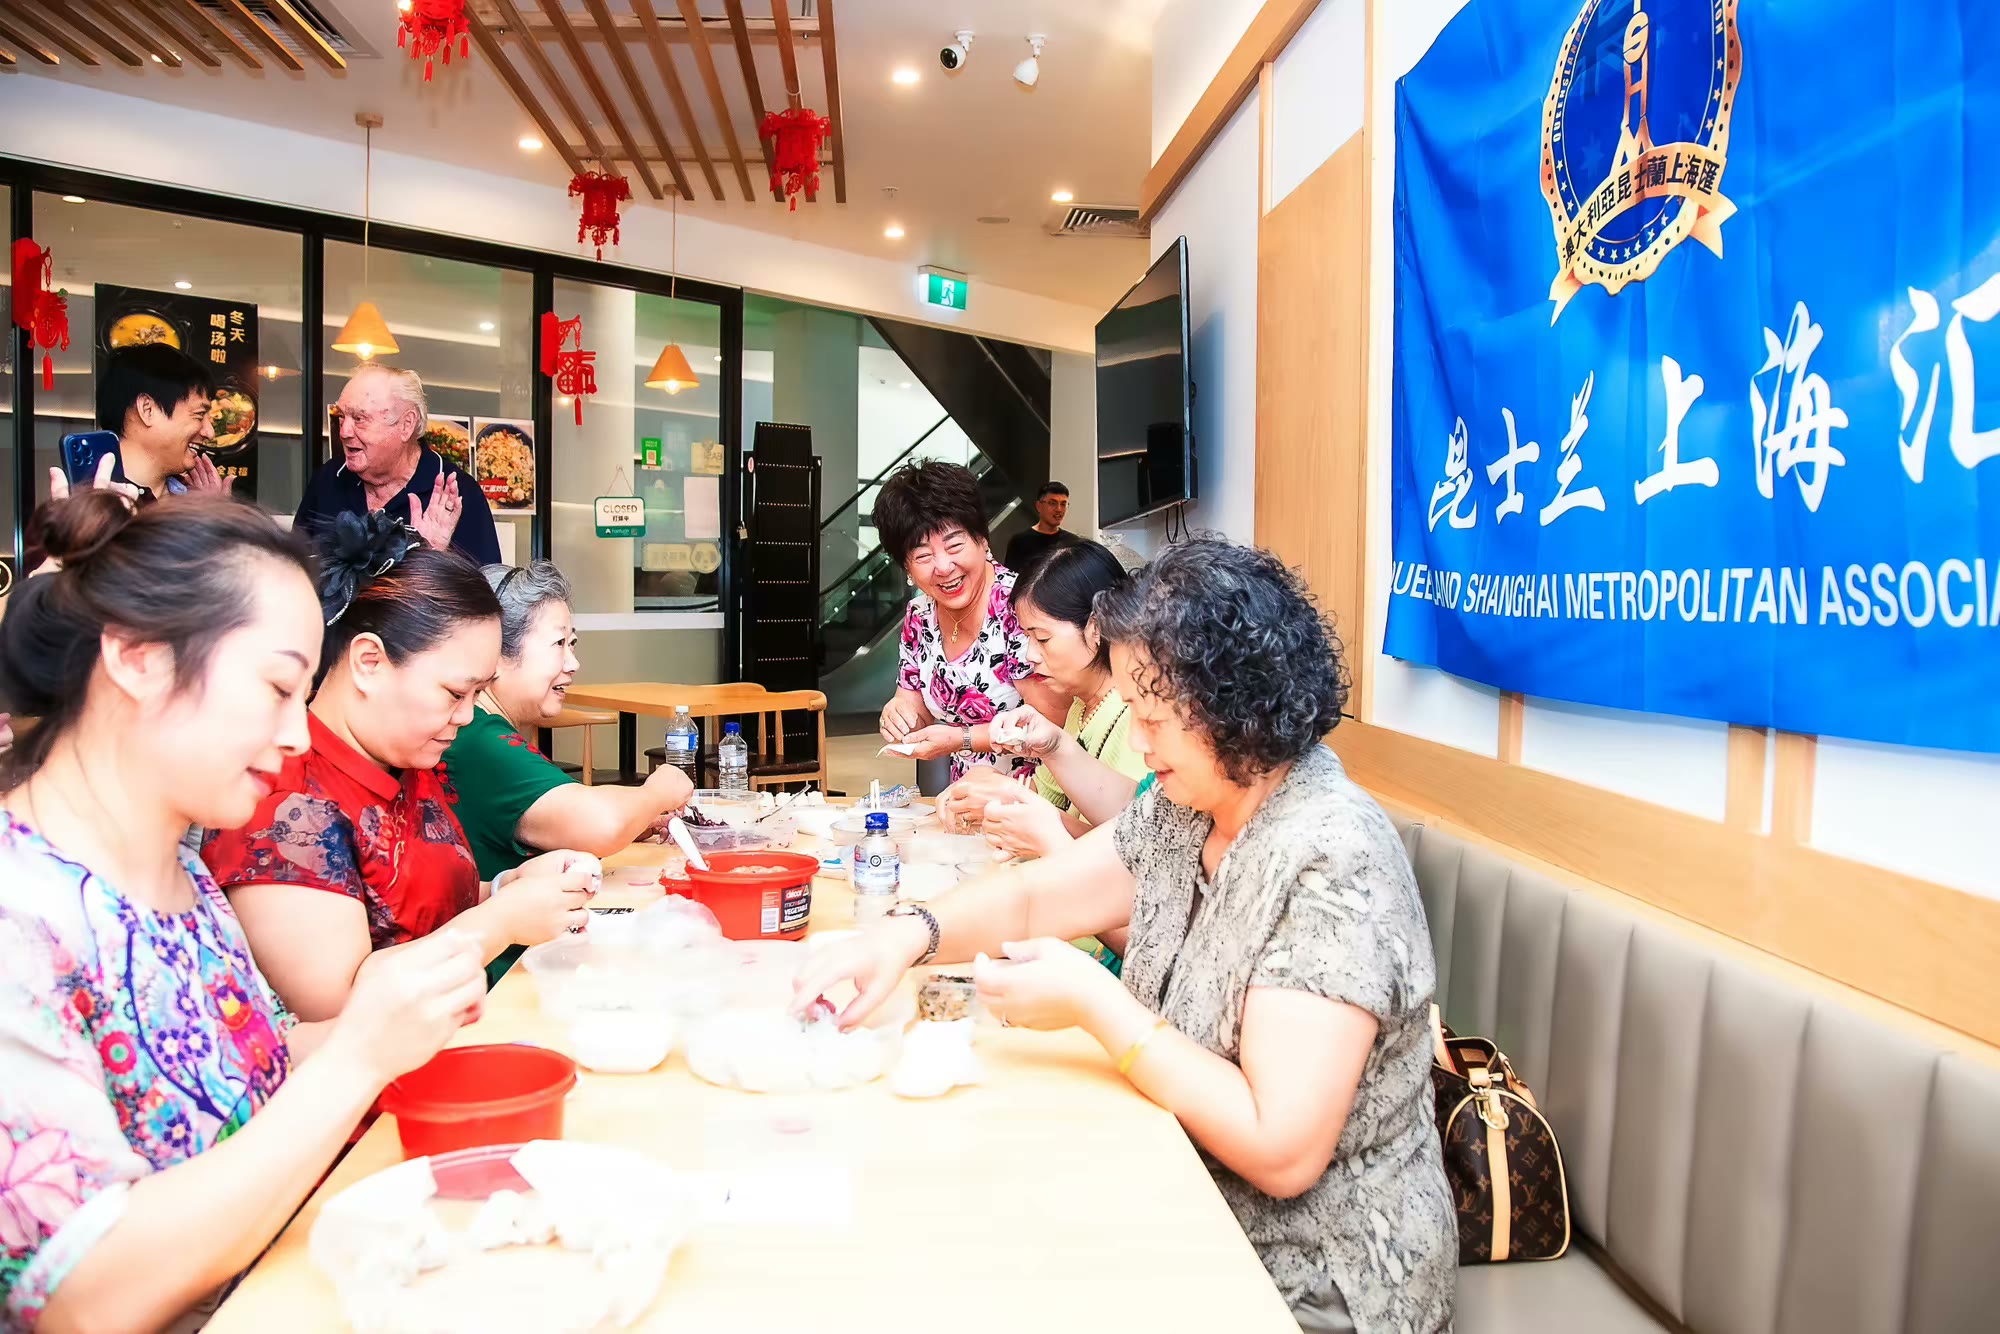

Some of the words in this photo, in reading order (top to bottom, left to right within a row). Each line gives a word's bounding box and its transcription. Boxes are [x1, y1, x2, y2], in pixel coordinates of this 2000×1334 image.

[1562, 152, 1720, 268] 澳大利亞昆士蘭上海匯
[210, 314, 226, 363] 喝汤啦
[230, 310, 246, 343] 冬天
[1428, 274, 2000, 532] 昆士兰上海汇
[602, 504, 638, 514] CLOSED
[1463, 573, 1559, 618] SHANGHAI
[1564, 567, 1808, 625] METROPOLITAN
